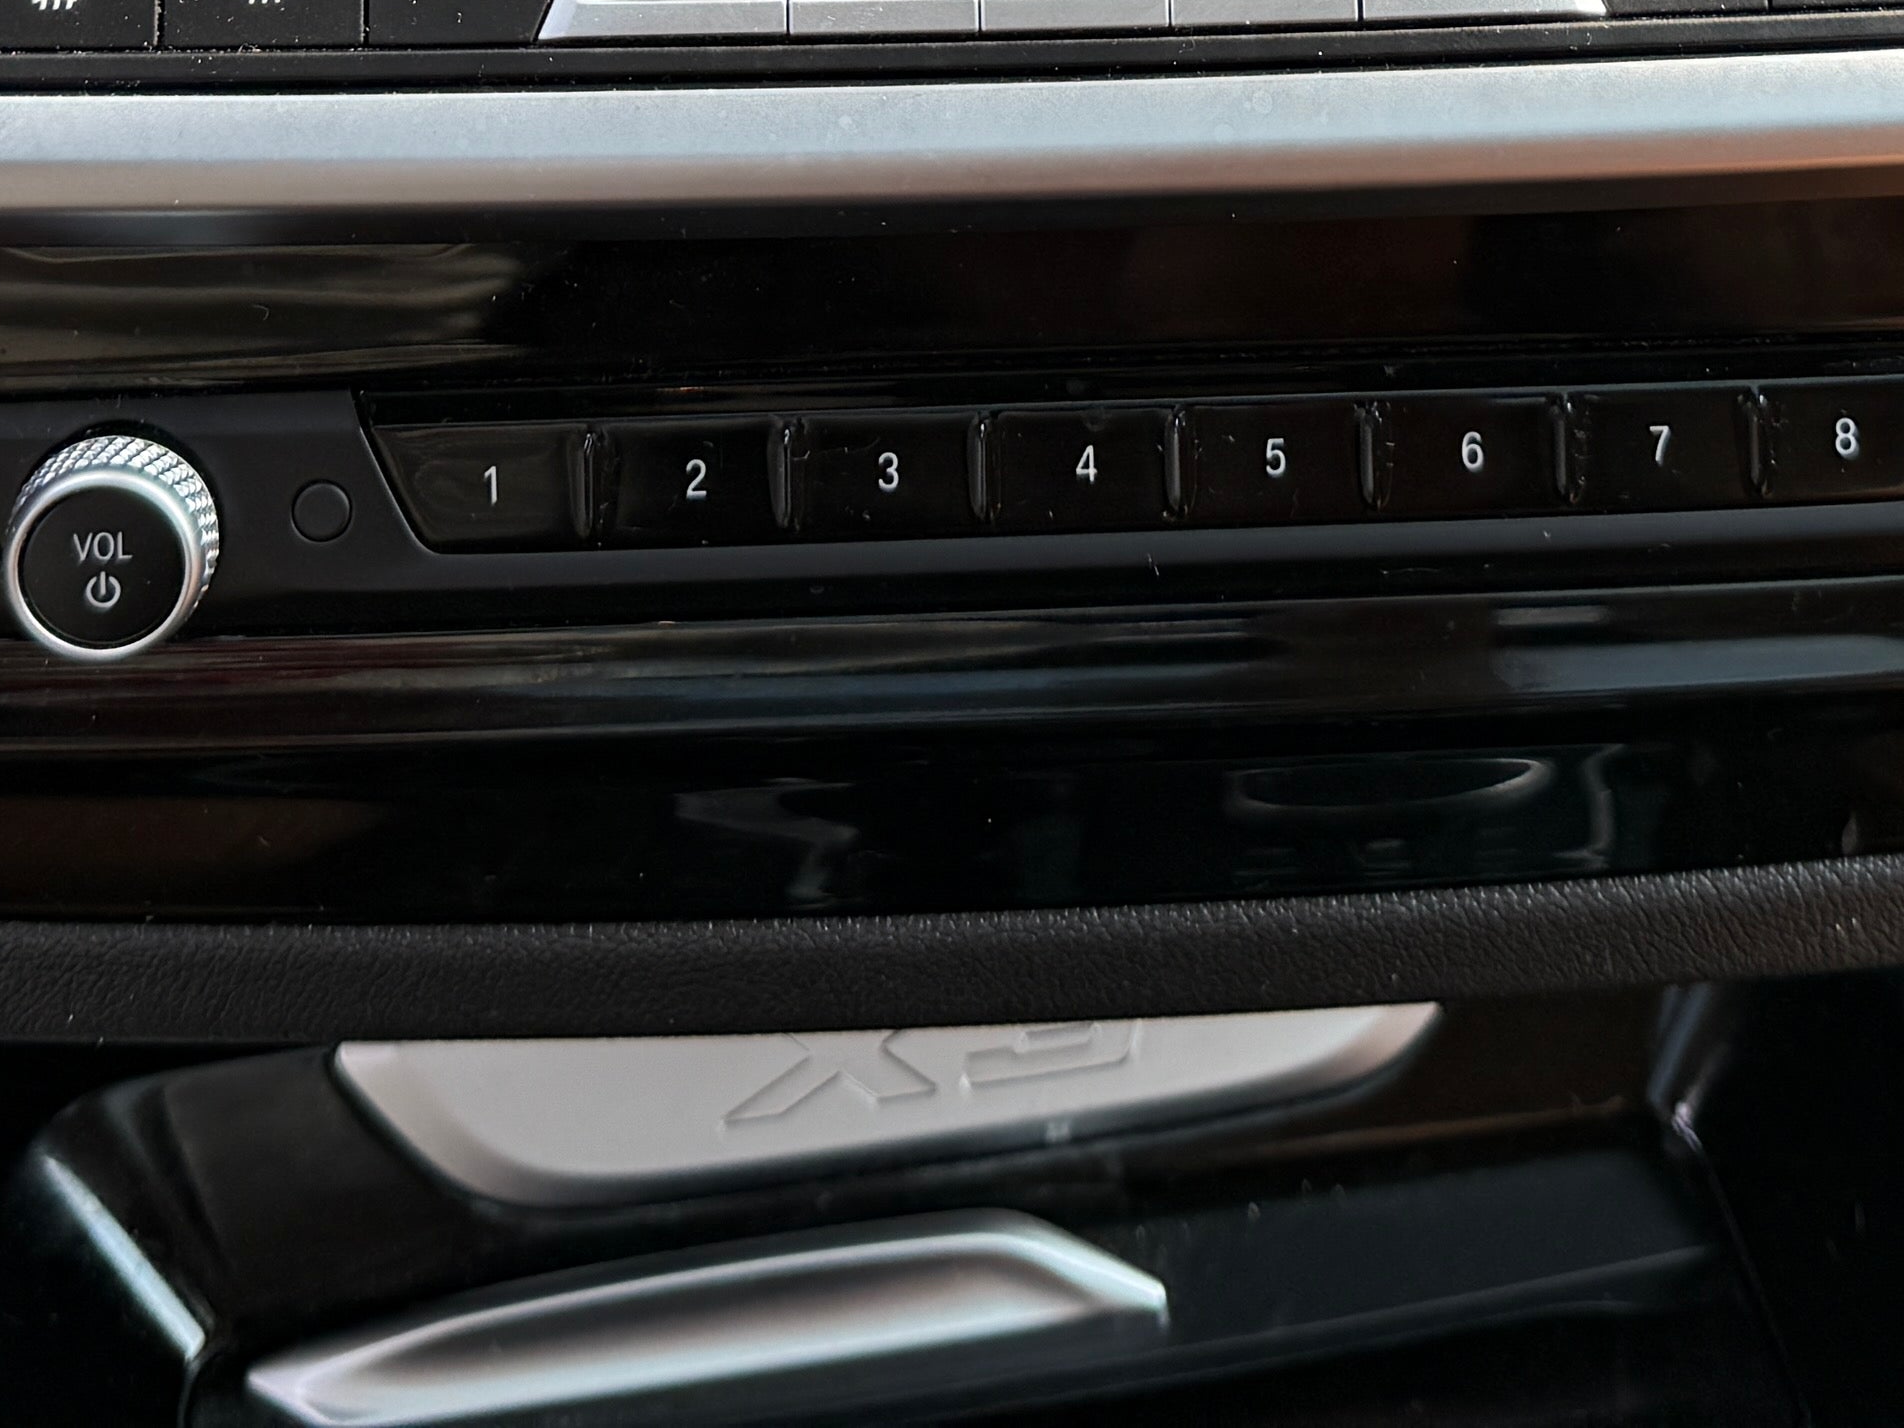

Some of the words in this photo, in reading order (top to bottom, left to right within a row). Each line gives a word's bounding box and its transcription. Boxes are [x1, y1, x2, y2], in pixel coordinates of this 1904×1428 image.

[1264, 437, 1288, 480] 5
[1459, 430, 1486, 472] 6
[1648, 423, 1673, 465] 7
[1832, 416, 1860, 459] 8
[481, 465, 500, 507] 1
[685, 458, 709, 501] 2
[877, 451, 901, 492] 3
[1074, 444, 1099, 486] 4
[71, 530, 135, 564] VOL
